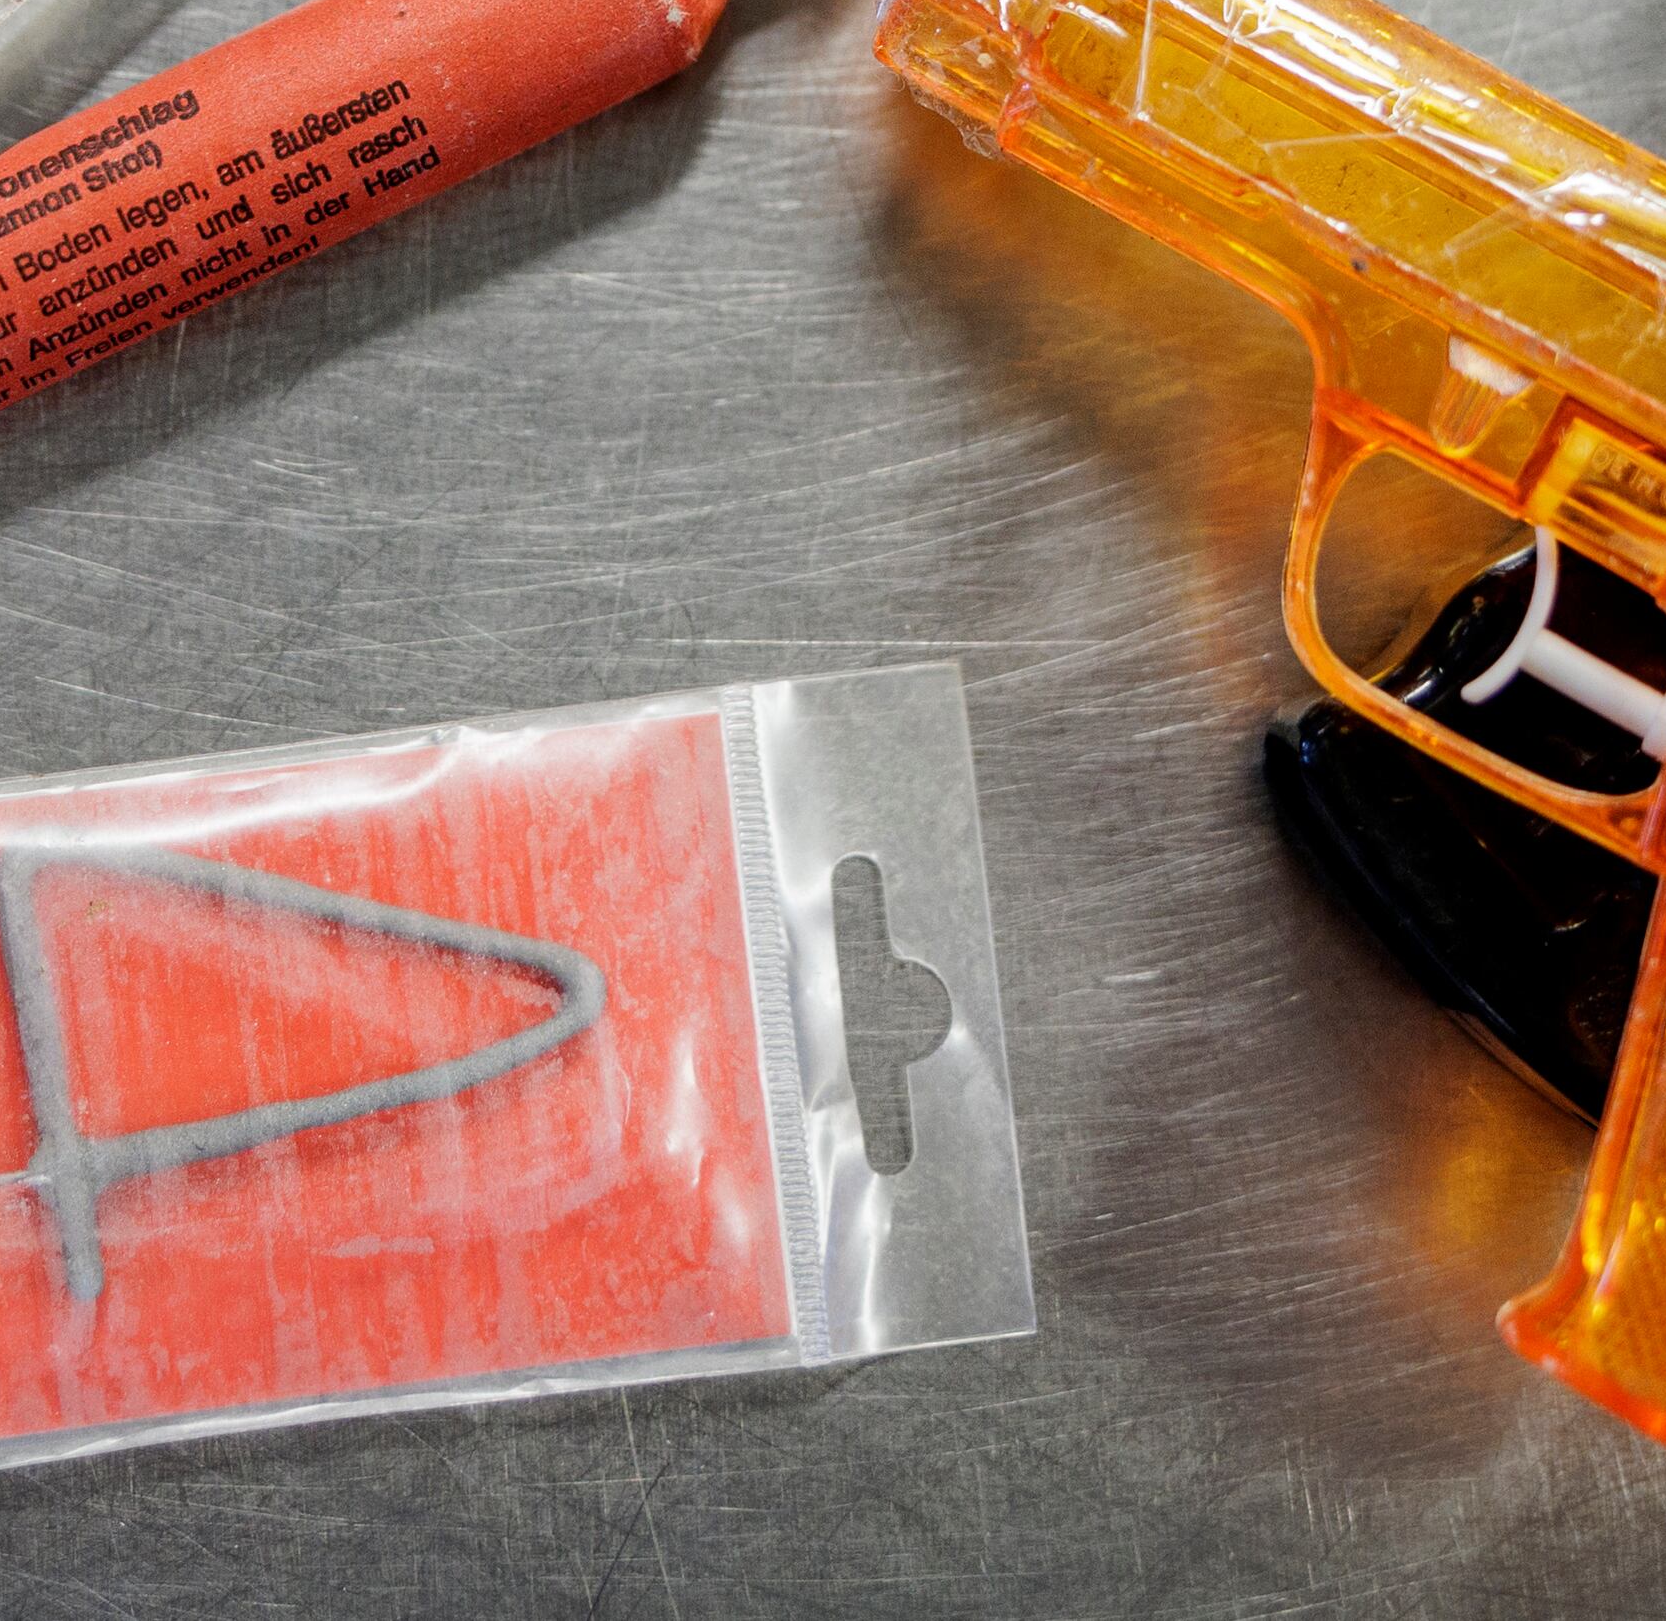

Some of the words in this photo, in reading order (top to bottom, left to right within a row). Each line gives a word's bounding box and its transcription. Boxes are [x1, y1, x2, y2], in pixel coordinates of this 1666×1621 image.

[13, 220, 113, 283] Boden
[116, 180, 210, 233] legen,
[216, 149, 265, 186] am
[270, 80, 411, 159] äußersten
[29, 283, 168, 361] Anzünden
[180, 240, 252, 285] nicht
[261, 224, 291, 247] in
[304, 192, 350, 226] der
[364, 146, 440, 197] Hand
[39, 237, 178, 317] anzünden
[195, 195, 254, 240] und
[270, 161, 332, 205] sich
[347, 116, 429, 168] rasch
[82, 139, 163, 192] Shot)
[21, 366, 57, 390] im
[65, 320, 152, 368] Freien
[161, 235, 321, 321] verwenden!
